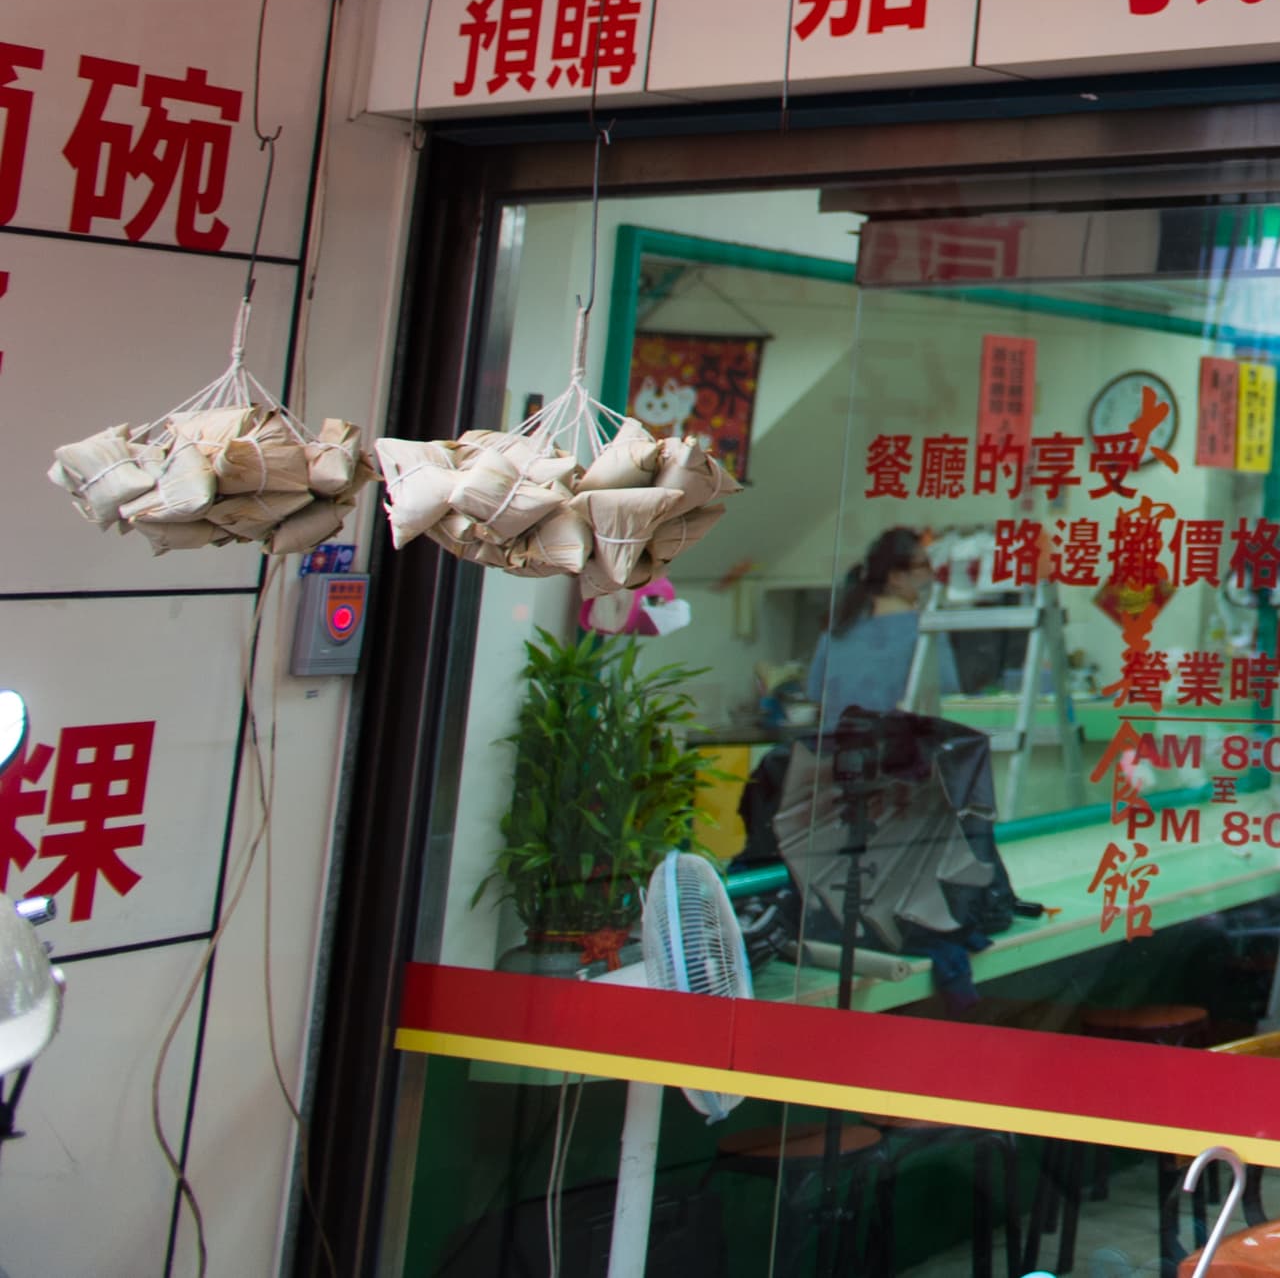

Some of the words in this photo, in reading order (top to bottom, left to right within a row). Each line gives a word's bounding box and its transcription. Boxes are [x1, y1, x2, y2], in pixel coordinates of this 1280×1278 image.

[865, 431, 1140, 500] 餐廳的享受
[1132, 732, 1202, 769] AM
[1210, 775, 1239, 805] 至
[1126, 807, 1201, 843] PM
